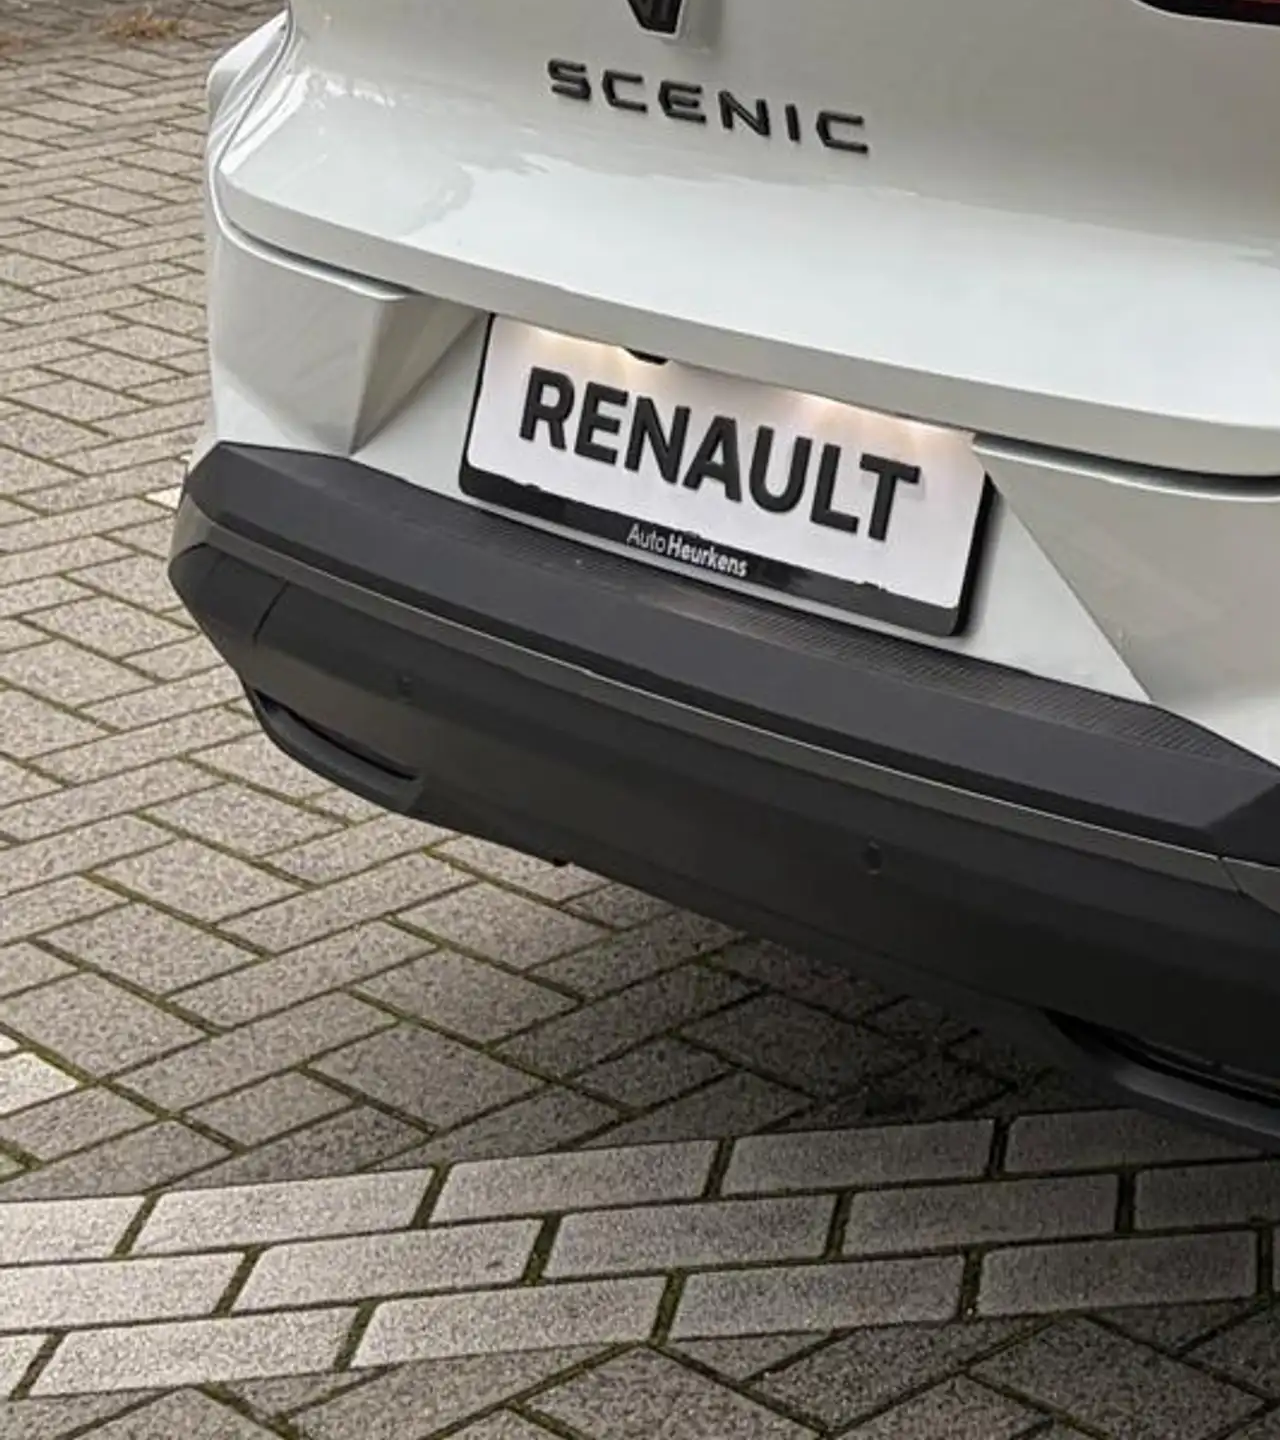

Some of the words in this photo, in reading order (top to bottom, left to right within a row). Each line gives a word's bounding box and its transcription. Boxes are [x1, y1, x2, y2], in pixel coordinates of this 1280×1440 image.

[547, 58, 869, 156] SCENIC
[518, 366, 920, 543] RENAULT
[626, 523, 667, 554] Auto
[667, 533, 748, 578] Heurkens
